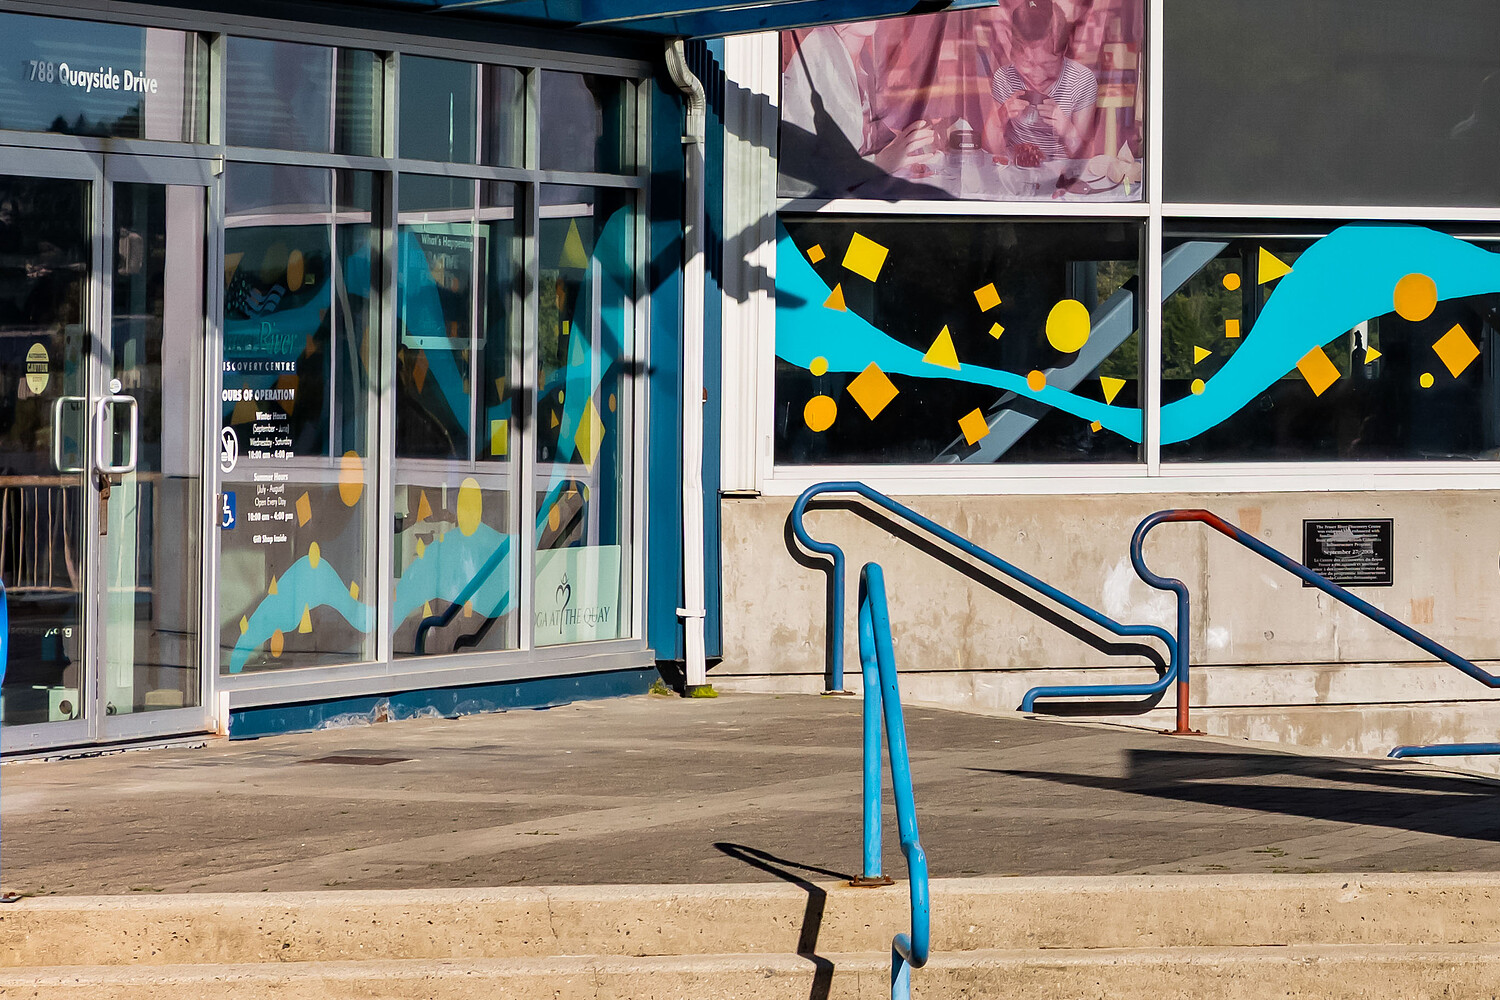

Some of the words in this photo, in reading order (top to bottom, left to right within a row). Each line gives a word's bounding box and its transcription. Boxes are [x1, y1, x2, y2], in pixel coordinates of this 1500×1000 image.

[30, 60, 54, 83] 788
[59, 62, 119, 92] Quayside
[123, 69, 158, 94] Drive
[421, 233, 442, 246] What's
[223, 361, 262, 371] ISCOVERY
[265, 361, 296, 371] CENTRE
[222, 389, 243, 402] OURS
[243, 389, 254, 401] OF
[254, 389, 295, 401] OPERATION
[255, 411, 272, 420] Winter
[272, 412, 287, 420] Hours
[252, 423, 275, 434] (September
[275, 436, 292, 447] Saturday
[254, 472, 273, 481] Summer
[274, 472, 288, 481] Hours
[255, 497, 266, 507] Open
[267, 496, 277, 507] Every
[278, 496, 286, 507] Day
[262, 534, 273, 544] Shop
[274, 533, 287, 543] Inside
[565, 608, 581, 625] THE
[583, 606, 610, 628] QUAY
